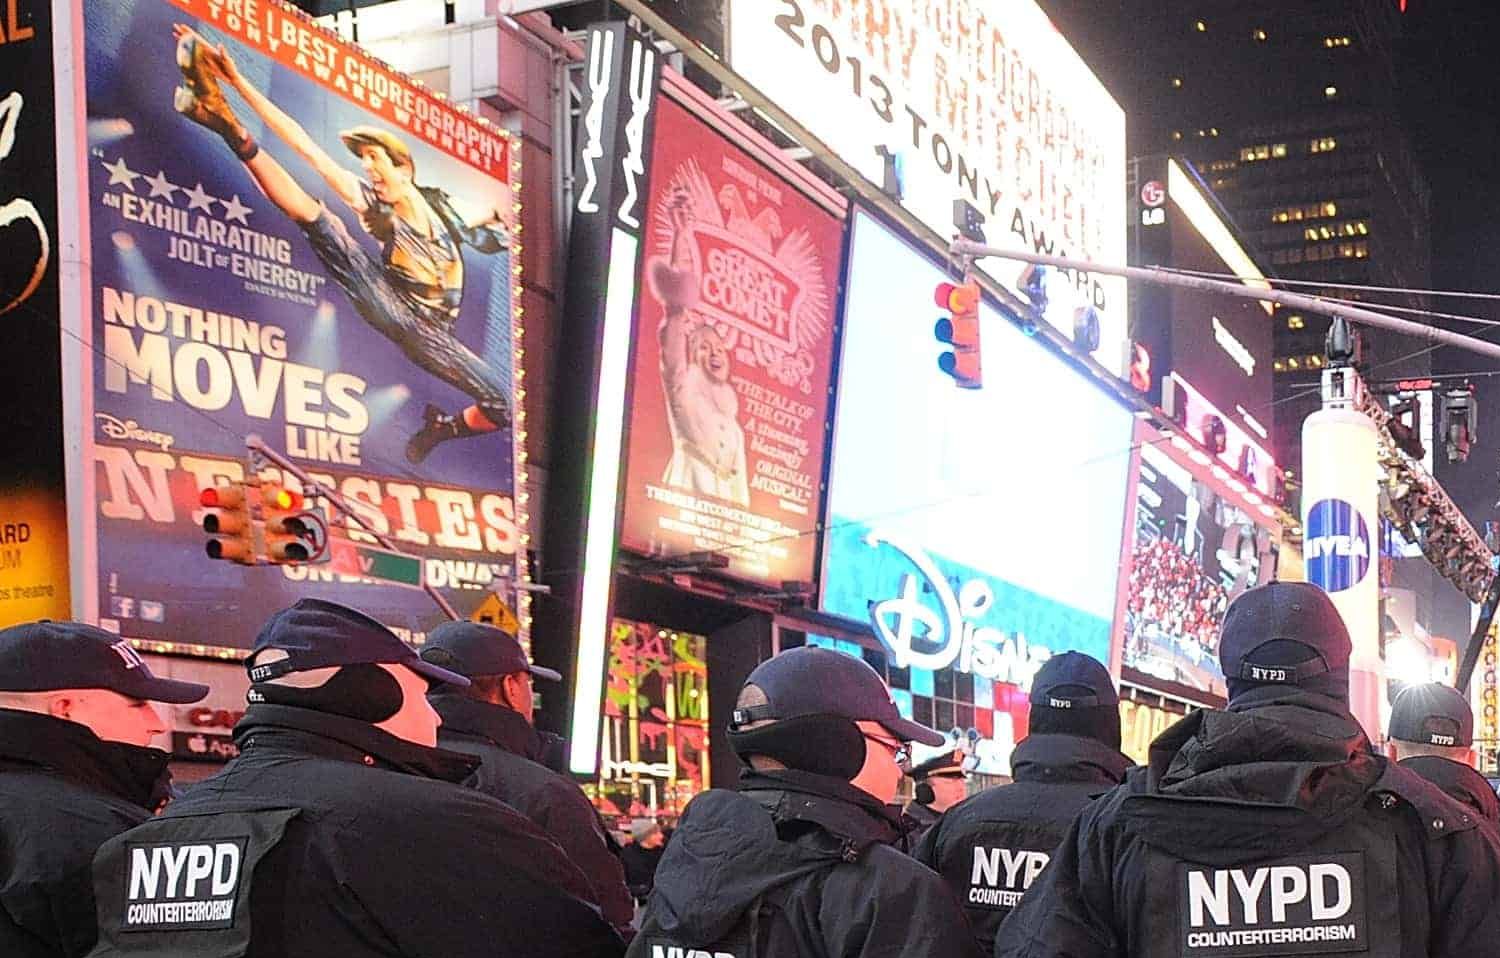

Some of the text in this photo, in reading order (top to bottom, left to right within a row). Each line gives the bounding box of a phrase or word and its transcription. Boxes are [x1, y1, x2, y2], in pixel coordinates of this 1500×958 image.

[208, 2, 281, 53] TONY
[295, 52, 383, 109] AWARD
[281, 17, 339, 70] BEST
[344, 55, 504, 162] CHOREOGRAPHY
[774, 0, 893, 124] 2013
[905, 104, 1003, 216] TONY
[102, 192, 292, 265] AN EXHILARATING
[168, 237, 216, 268] JOLT
[102, 287, 288, 359] NOTHING
[104, 323, 369, 434] MOVES
[285, 424, 362, 466] LIKE
[1251, 667, 1286, 682] NYPD
[128, 842, 240, 900] NYPD
[971, 846, 1051, 890] NYP
[1187, 863, 1353, 928] NYPD
[127, 898, 235, 925] COUNTERTERRORISM
[1187, 923, 1356, 948] COUNTERTERRORISM
